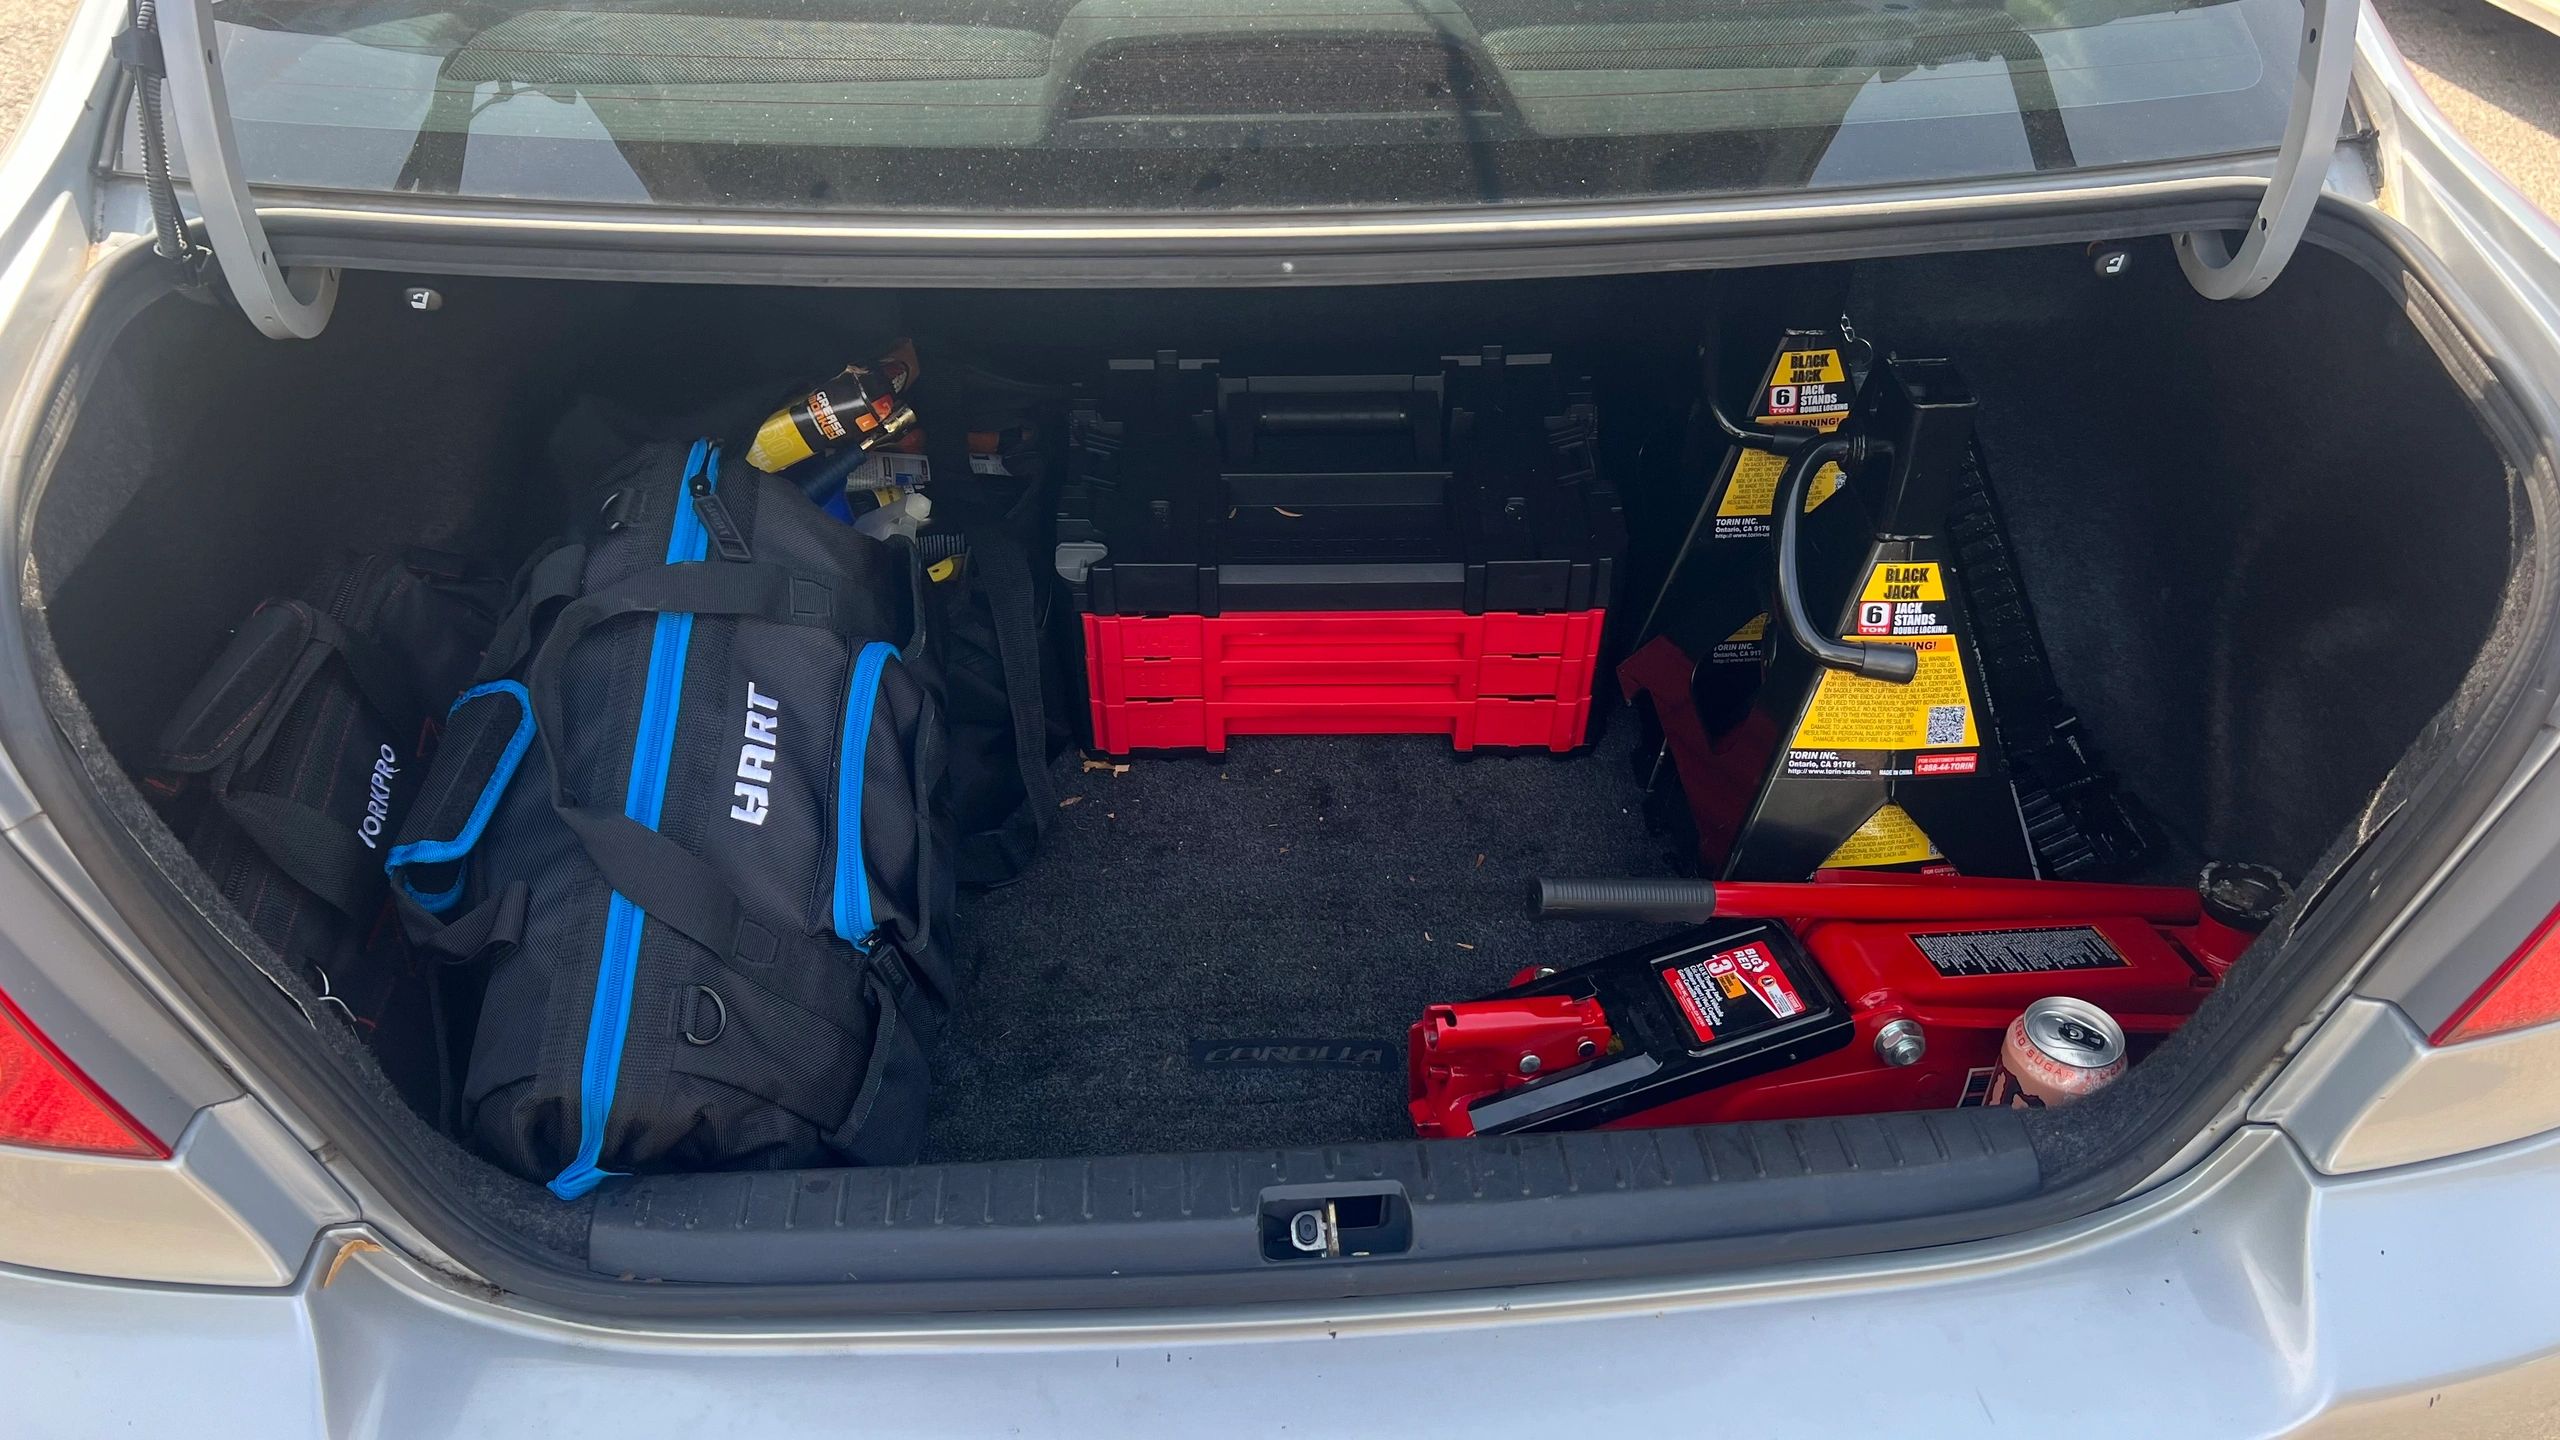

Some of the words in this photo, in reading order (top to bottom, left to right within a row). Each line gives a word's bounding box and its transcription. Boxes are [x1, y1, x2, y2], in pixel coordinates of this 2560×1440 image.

[1790, 354, 1830, 369] BLACK
[1790, 369, 1822, 382] JACK
[1776, 389, 1790, 406] 6
[1800, 384, 1824, 396] JACK
[1800, 394, 1838, 406] STANDS
[816, 391, 846, 436] GREASE
[1800, 405, 1822, 413] DOUBLE
[1823, 403, 1848, 412] LOCKING
[1885, 568, 1930, 583] BLACK
[1884, 585, 1920, 599] JACK
[1866, 606, 1883, 624] 6
[1895, 602, 1923, 614] JACK
[1894, 614, 1936, 626] STANDS
[1893, 626, 1918, 635] DOUBLE
[1919, 625, 1948, 634] LOCKING
[730, 681, 779, 826] HART
[1733, 951, 1752, 970] RED
[1744, 948, 1762, 966] BIG
[1708, 959, 1733, 974] 3
[1204, 1046, 1382, 1064] COROLLA
[2027, 1049, 2075, 1078] SUGAR
